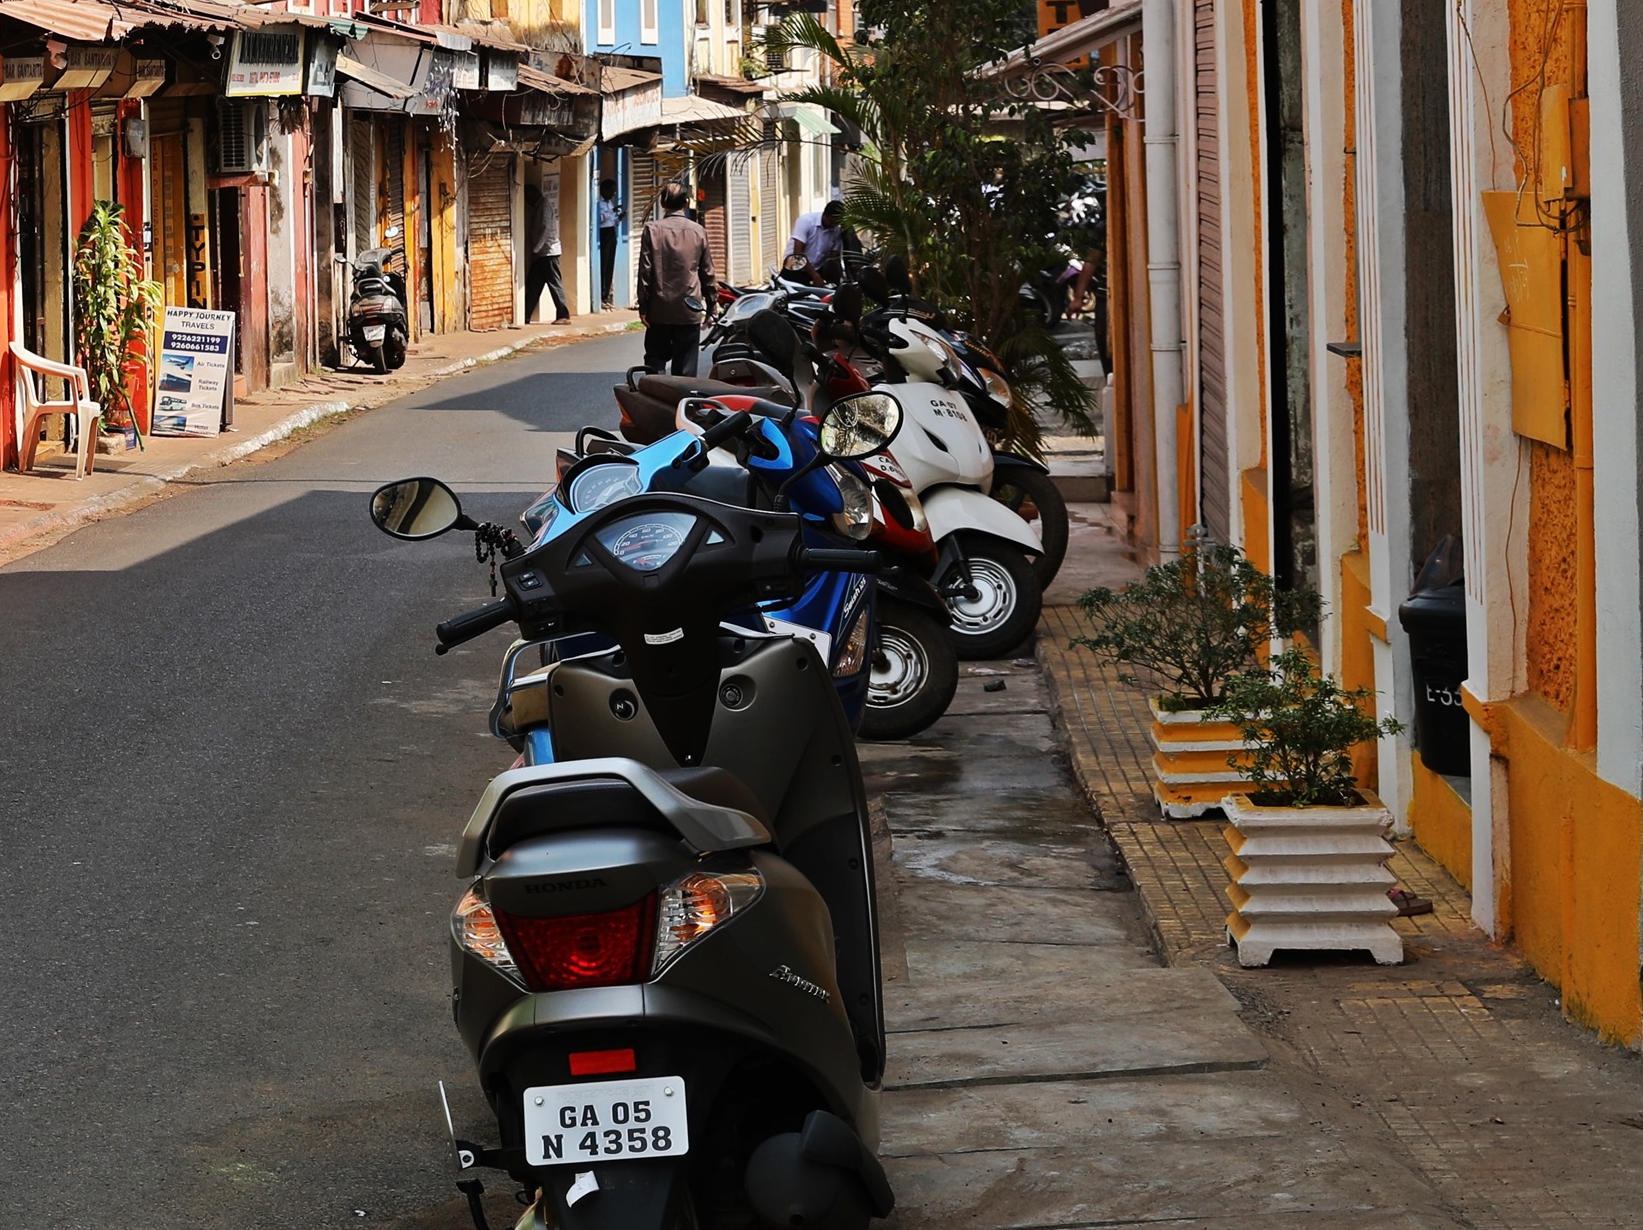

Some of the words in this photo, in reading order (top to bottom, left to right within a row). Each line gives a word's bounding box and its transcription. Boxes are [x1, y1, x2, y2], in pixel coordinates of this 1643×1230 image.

[69, 52, 82, 66] BAR
[5, 64, 16, 79] BAR
[167, 309, 193, 319] HAPPY
[195, 311, 232, 322] JOURNEY
[181, 321, 215, 330] TRAVELS
[171, 333, 221, 344] 9226221199
[198, 379, 219, 387] Railway
[523, 876, 609, 895] HONDA
[559, 1104, 600, 1129] GA
[611, 1100, 652, 1125] 05
[542, 1134, 564, 1159] N
[579, 1125, 672, 1156] 4358
